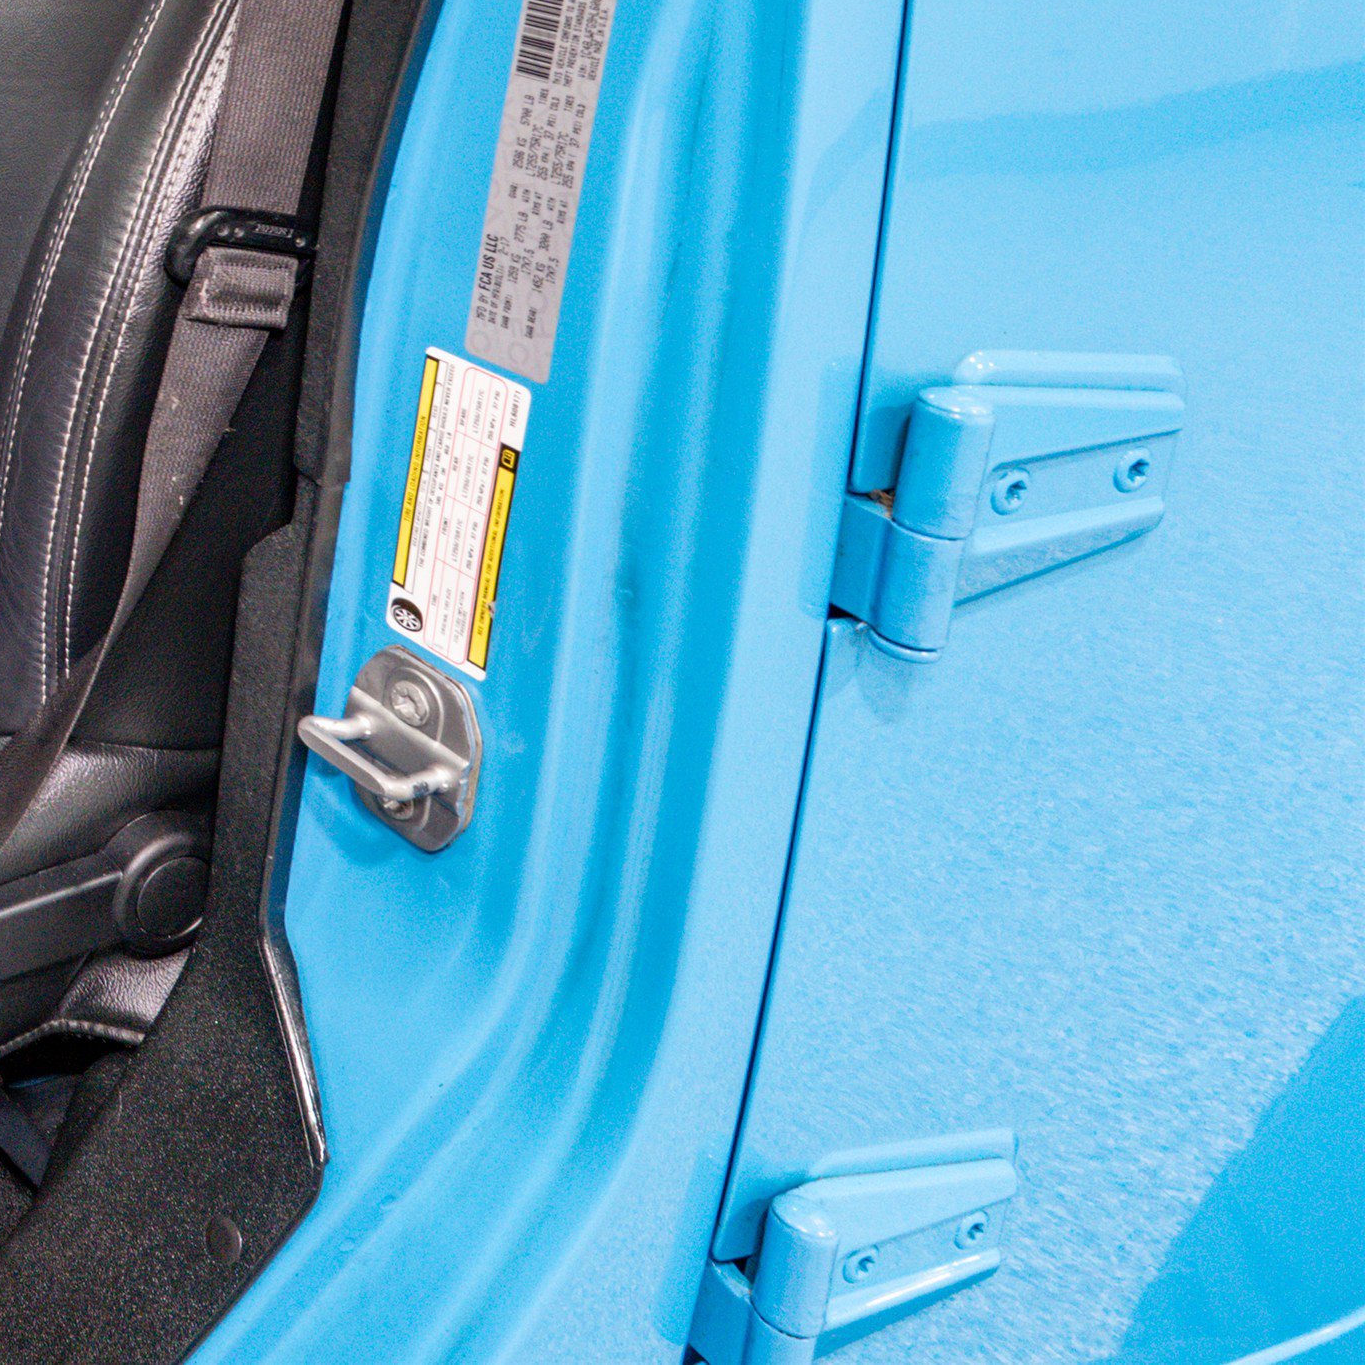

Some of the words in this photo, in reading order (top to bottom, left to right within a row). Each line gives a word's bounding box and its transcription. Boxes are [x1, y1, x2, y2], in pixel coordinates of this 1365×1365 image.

[515, 136, 527, 147] KG
[523, 93, 534, 105] LB
[516, 210, 528, 222] LB
[484, 233, 498, 253] LLC
[512, 223, 526, 243] 2775
[534, 260, 546, 272] KG
[541, 219, 553, 230] LB
[481, 253, 495, 269] US
[509, 252, 521, 263] KG
[478, 270, 492, 291] FCA
[477, 292, 488, 303] BY
[403, 507, 411, 522] TIRE
[408, 460, 418, 491] LOADING
[413, 414, 425, 460] INFORMATION
